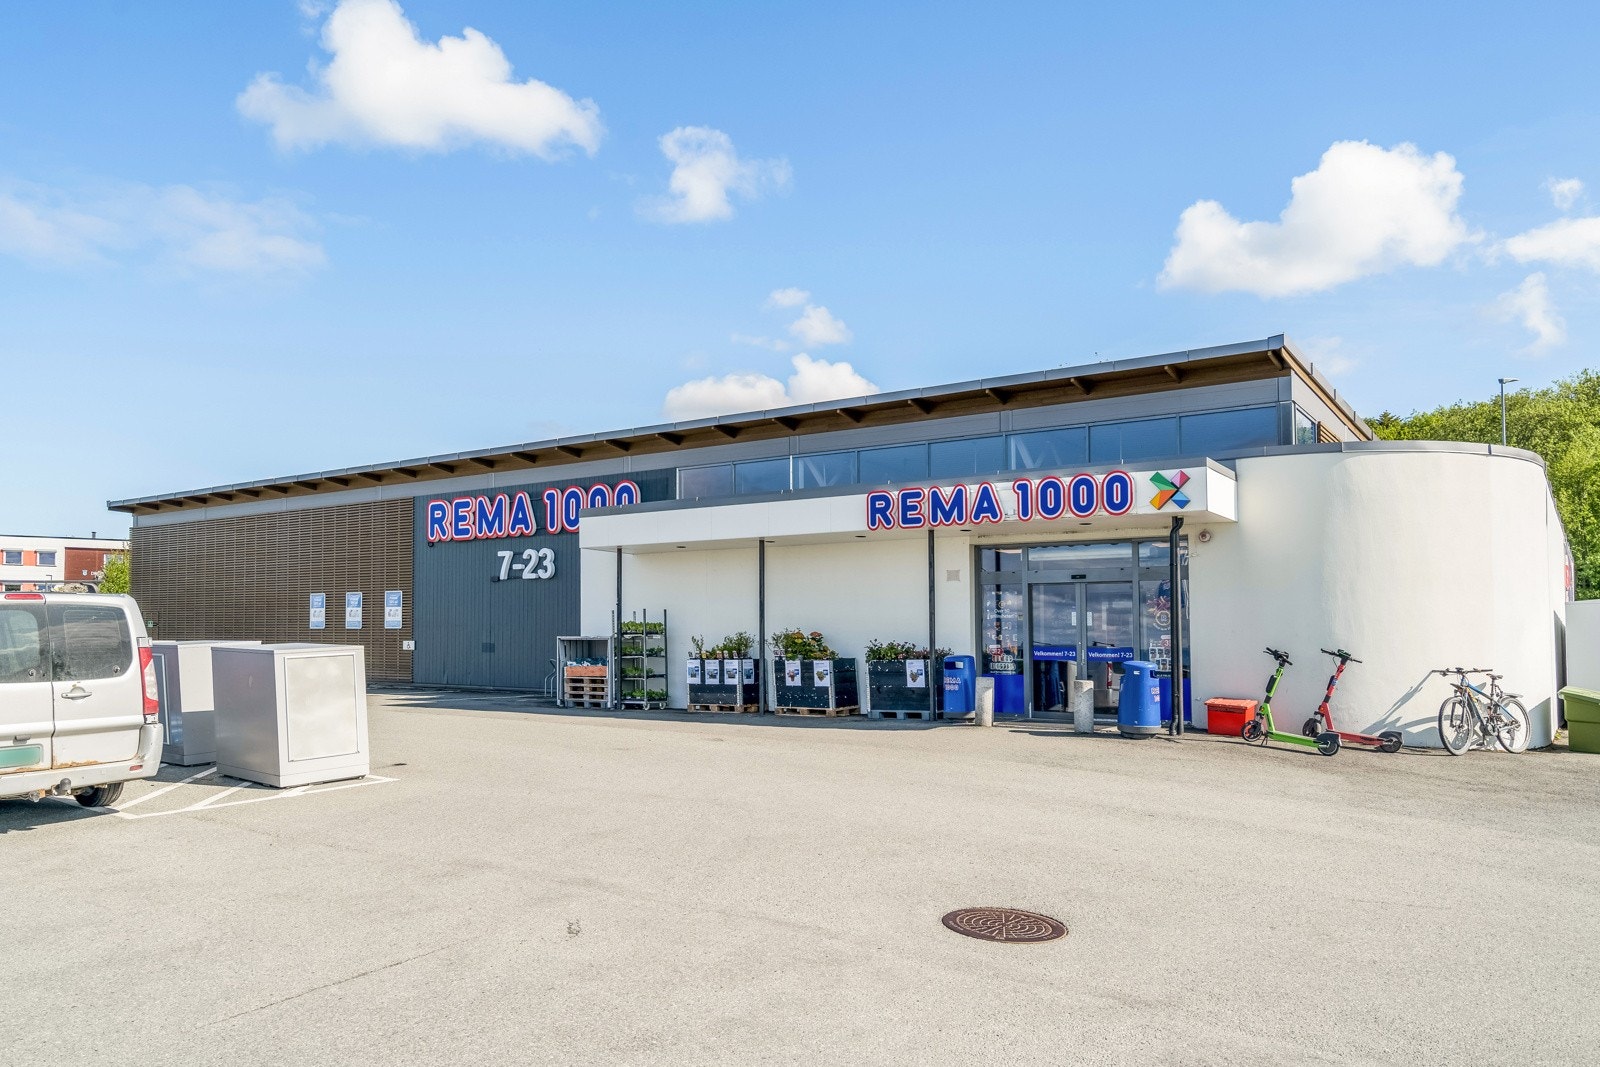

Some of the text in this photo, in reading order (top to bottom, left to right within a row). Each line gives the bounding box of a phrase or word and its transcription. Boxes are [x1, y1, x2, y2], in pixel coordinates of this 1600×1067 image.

[426, 491, 537, 542] REMA
[866, 470, 1133, 531] REMA 1000
[497, 547, 556, 580] 7-23
